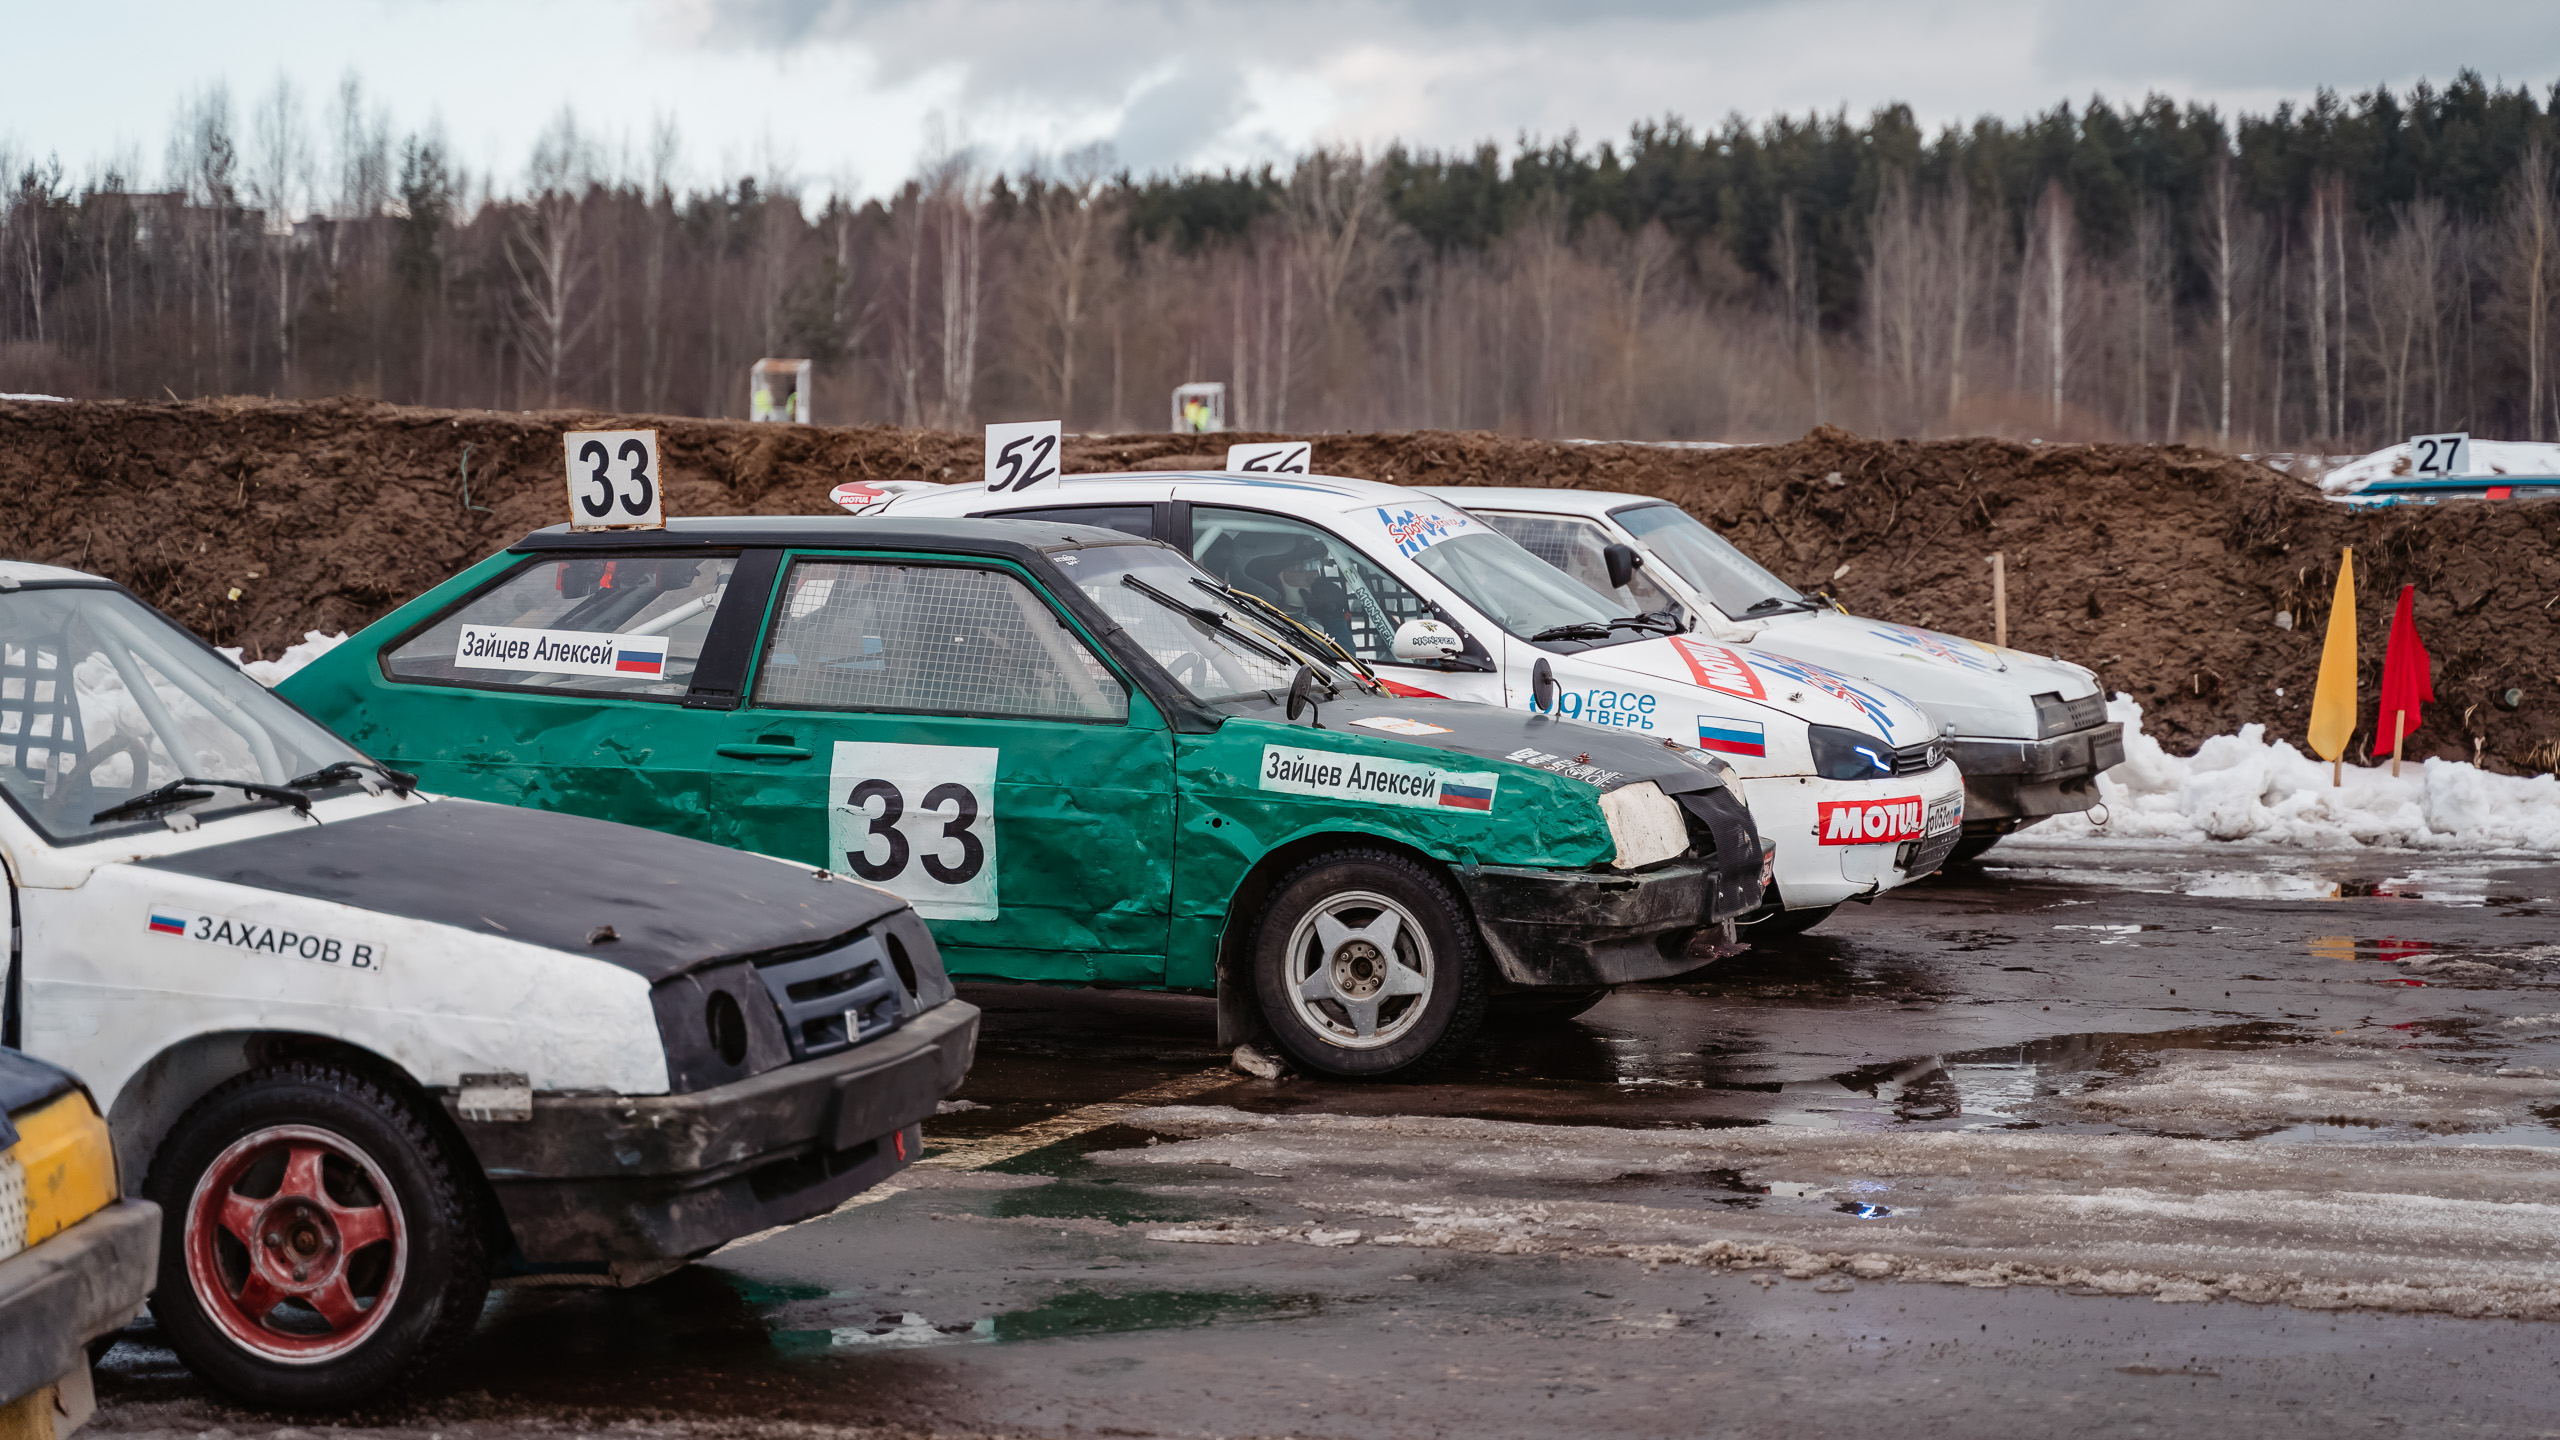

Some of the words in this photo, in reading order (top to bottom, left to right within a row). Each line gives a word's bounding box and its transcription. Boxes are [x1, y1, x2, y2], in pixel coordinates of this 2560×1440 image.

[987, 435, 1056, 492] 52
[2418, 438, 2461, 472] 27
[579, 439, 653, 517] 33
[840, 496, 869, 504] MOTUL
[1389, 514, 1430, 544] Sport
[462, 631, 530, 662] Зайцев
[533, 636, 613, 665] Алексей
[1588, 688, 1656, 714] race
[1586, 709, 1654, 730] ТВЕРЬ
[1266, 752, 1342, 788] Зайцев
[1346, 762, 1436, 798] Алексей
[846, 779, 984, 885] 33
[1826, 802, 1920, 839] MOTUL
[194, 916, 342, 963] ЗАХАРОВ
[351, 944, 379, 971] В.
